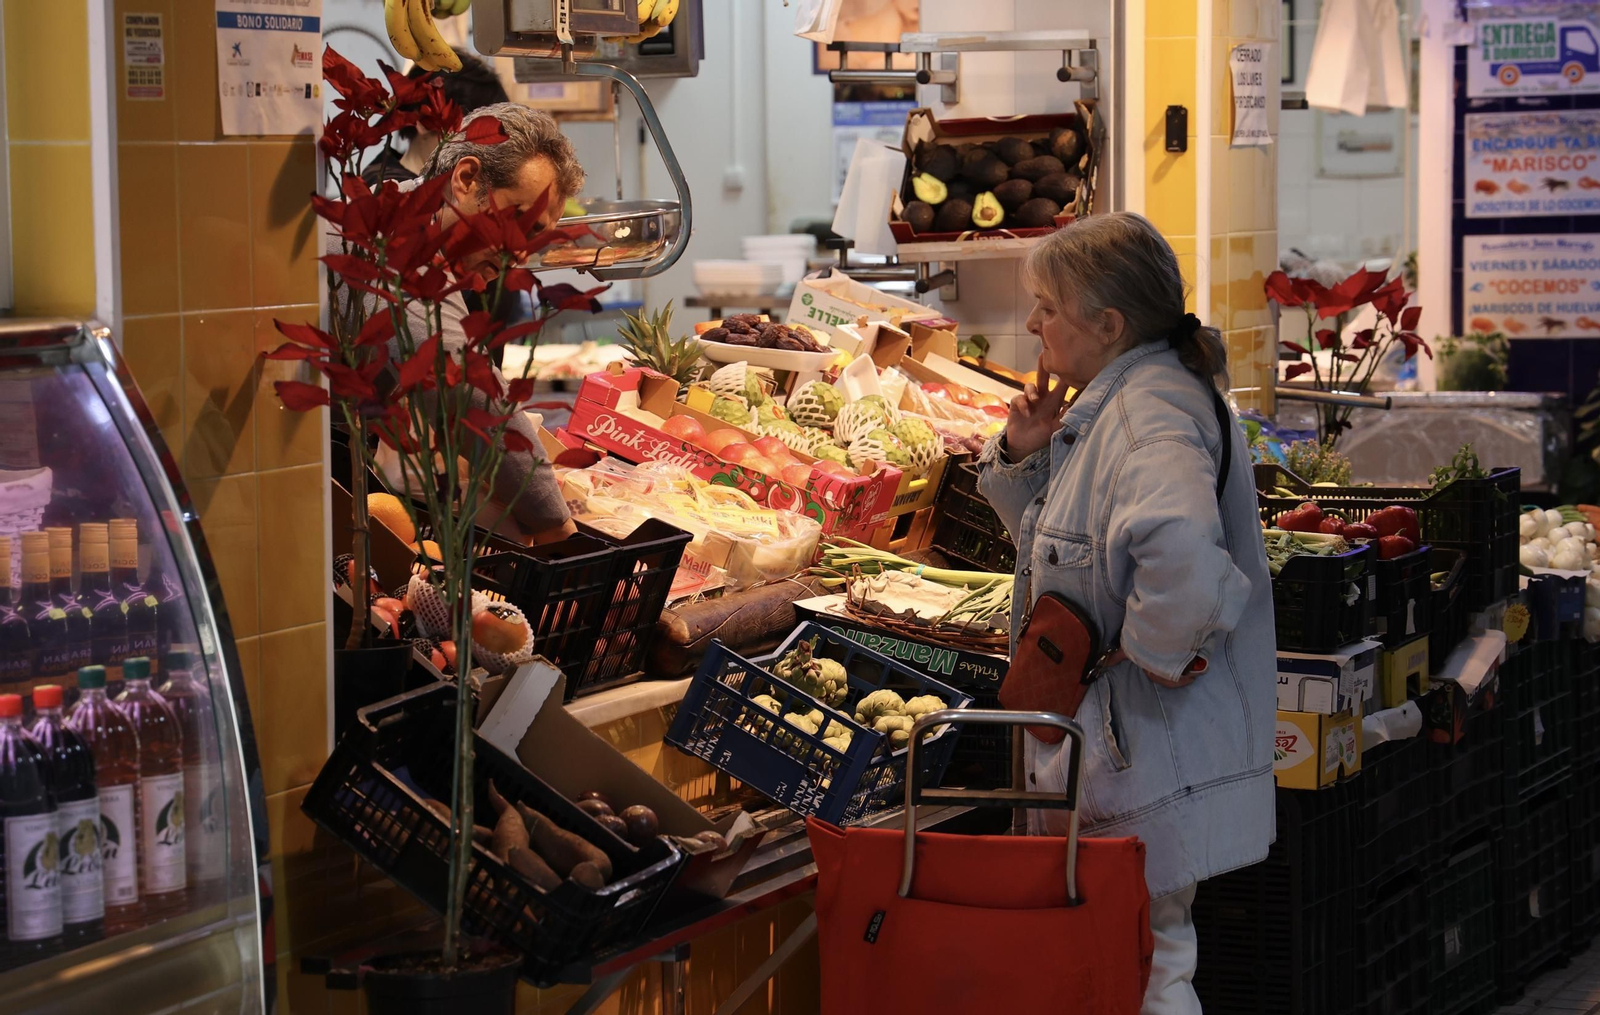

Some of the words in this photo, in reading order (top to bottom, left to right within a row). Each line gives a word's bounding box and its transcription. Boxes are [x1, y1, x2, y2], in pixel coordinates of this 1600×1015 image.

[236, 14, 262, 28] BONO
[264, 15, 303, 30] SOLIDARIO
[1482, 22, 1556, 45] ENTREGA
[1236, 48, 1261, 62] CERRADO
[1493, 45, 1556, 60] DOMICILIO
[1472, 135, 1557, 152] ENCARGUE
[1470, 259, 1527, 272] VIERNES
[1531, 259, 1538, 271] Y
[1537, 303, 1552, 314] DE
[586, 413, 645, 450] Pink
[642, 438, 699, 472] Lady
[958, 661, 1000, 681] Frutas
